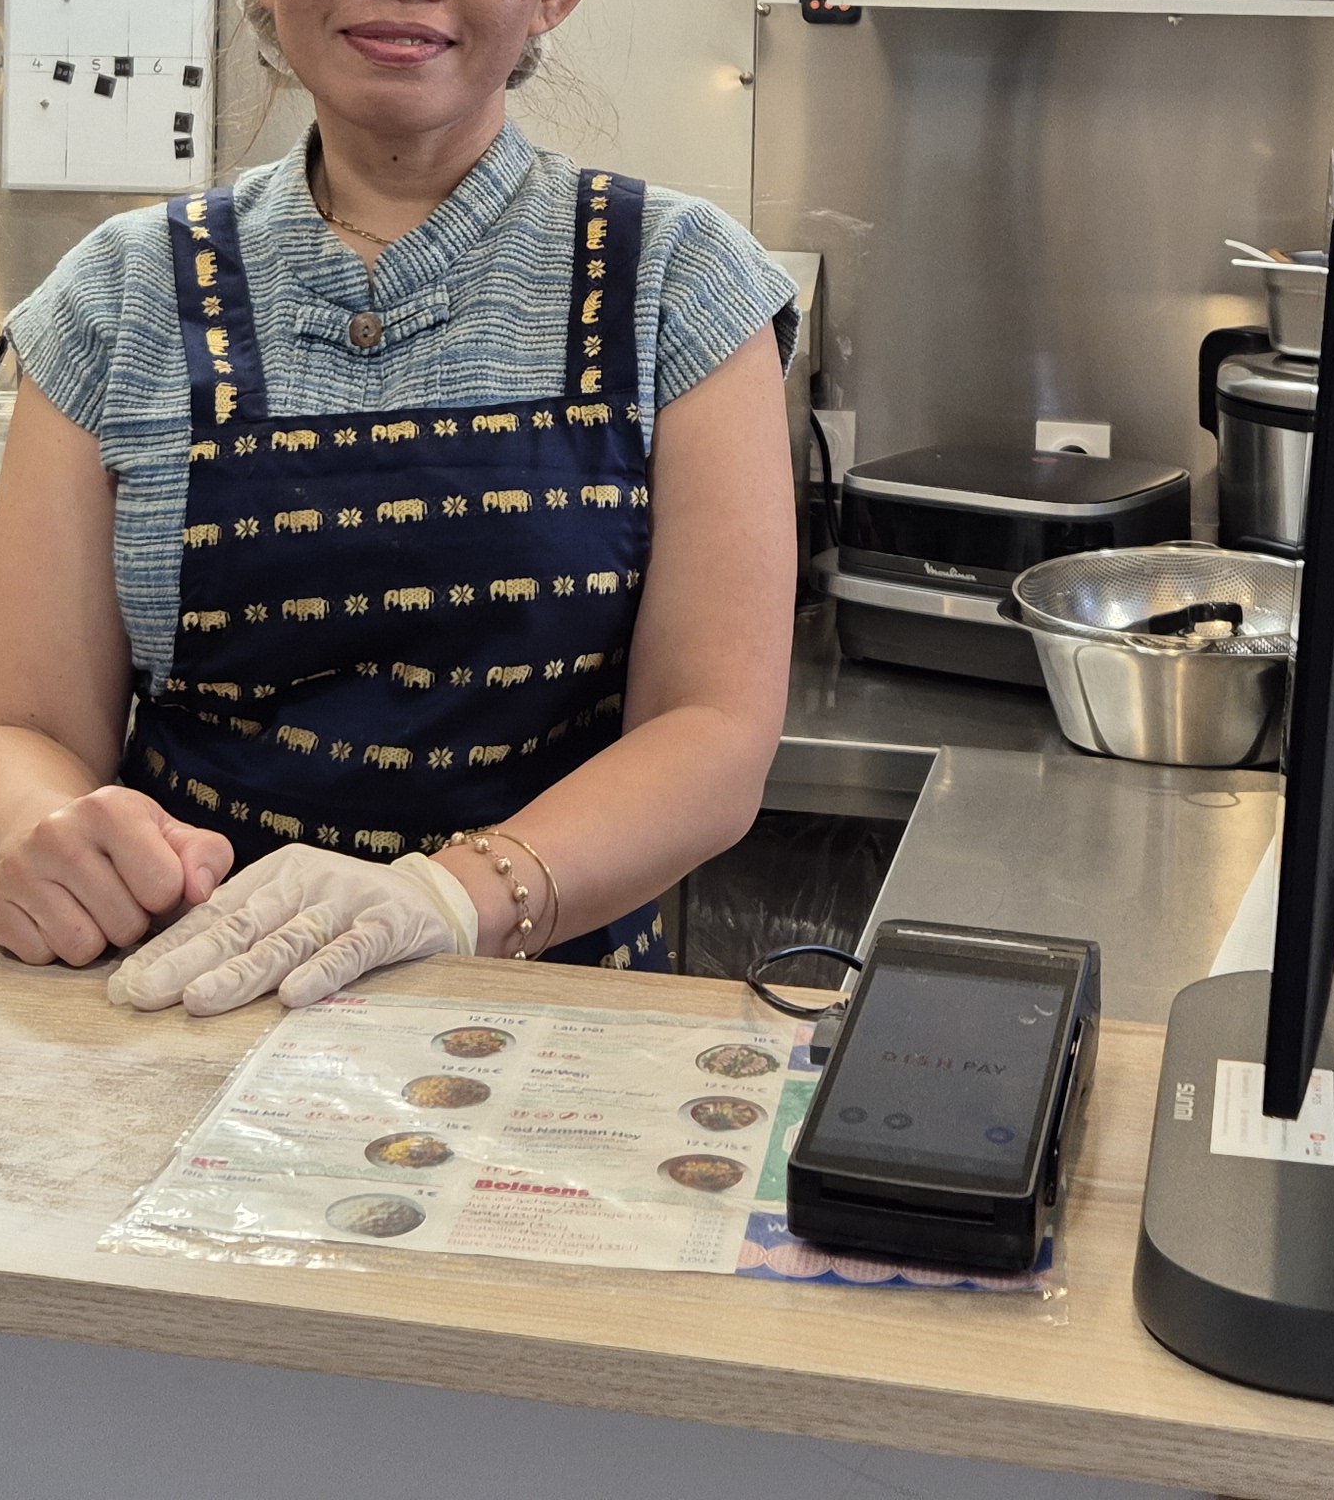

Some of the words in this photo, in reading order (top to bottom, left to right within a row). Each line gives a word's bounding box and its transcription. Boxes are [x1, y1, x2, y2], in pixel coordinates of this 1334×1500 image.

[32, 58, 44, 70] 4
[91, 58, 102, 71] 5
[152, 58, 163, 73] 6
